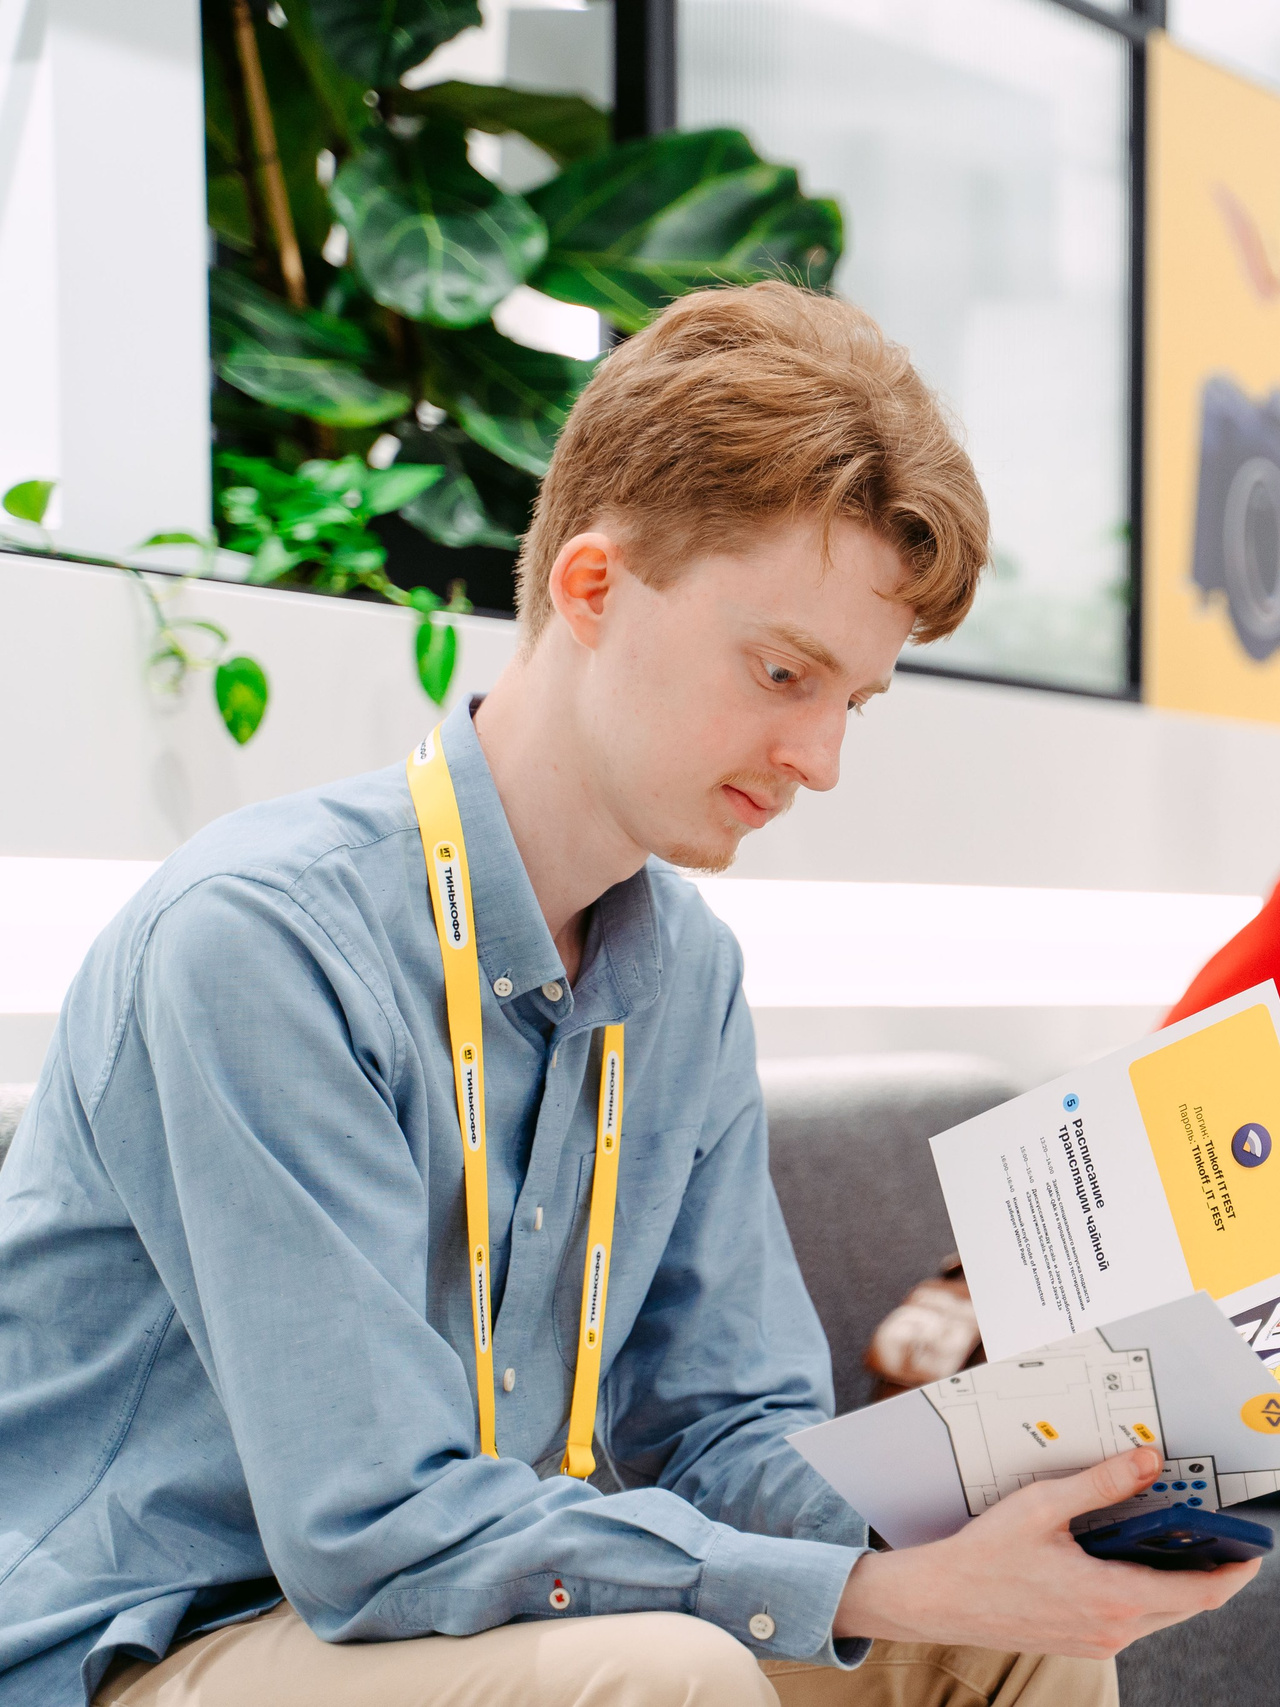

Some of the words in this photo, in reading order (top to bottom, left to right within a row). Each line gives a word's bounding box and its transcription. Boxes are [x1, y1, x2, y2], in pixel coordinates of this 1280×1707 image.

[444, 866, 461, 942] ТИНЬКОФФ
[466, 1069, 476, 1144] ТИНЬКОФФ
[607, 1058, 615, 1129] ТИНЬКОФФ
[1066, 1098, 1076, 1107] 5
[1193, 1106, 1209, 1140] Логин:
[1072, 1118, 1105, 1209] Расписание
[1178, 1103, 1196, 1145] Пароль:
[1192, 1144, 1225, 1231] Tinkoff_IT_FEST
[1205, 1140, 1224, 1180] Tinkoff
[1217, 1181, 1228, 1191] IT
[1026, 1191, 1035, 1214] «Зачем
[1032, 1214, 1041, 1235] нужна
[1038, 1234, 1046, 1254] Scala,
[1031, 1188, 1045, 1223] Дискуссия
[1042, 1223, 1051, 1244] между
[1058, 1124, 1091, 1214] трансляции
[1086, 1215, 1110, 1272] чайной
[1221, 1193, 1236, 1218] FEST
[1012, 1197, 1024, 1228] Книжный
[1021, 1228, 1029, 1243] клуб
[1025, 1243, 1033, 1260] Code
[1032, 1268, 1046, 1306] Architecture
[1014, 1228, 1022, 1248] White
[1020, 1248, 1028, 1266] Paper
[1052, 1179, 1061, 1202] Запись
[1058, 1202, 1074, 1246] специального
[1071, 1246, 1082, 1274] выпуска
[1079, 1273, 1090, 1303] подкаста
[590, 1251, 601, 1324] ТИНЬКОФФ
[1070, 1266, 1085, 1311] тестировании
[1030, 1431, 1047, 1448] Mobile
